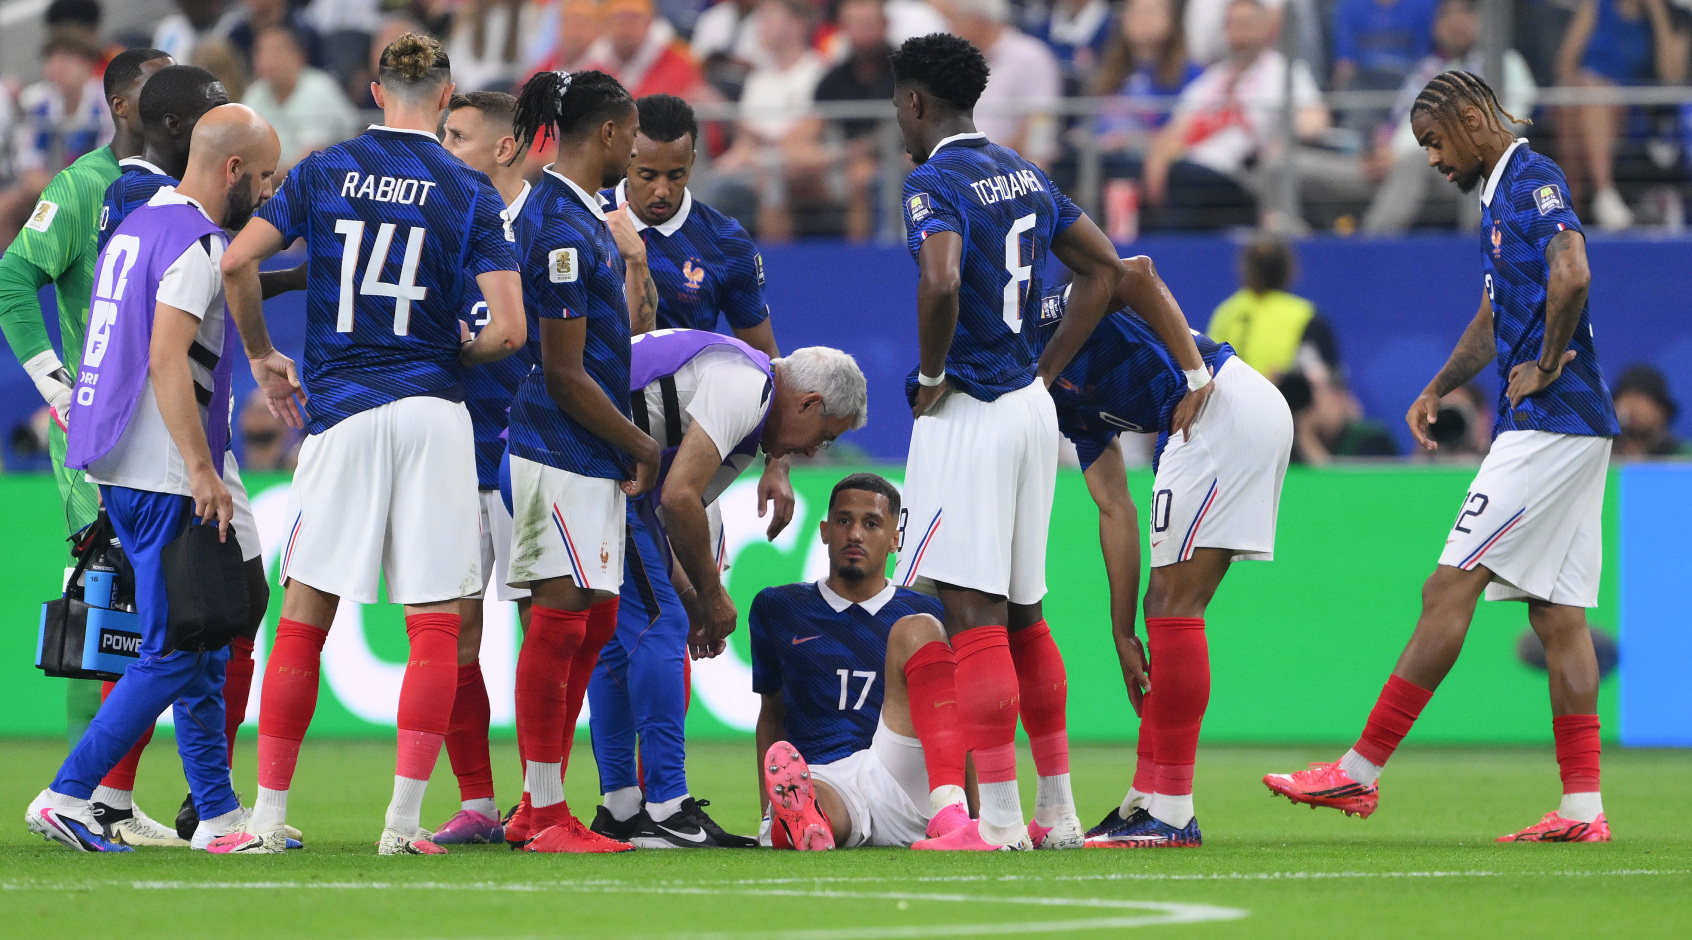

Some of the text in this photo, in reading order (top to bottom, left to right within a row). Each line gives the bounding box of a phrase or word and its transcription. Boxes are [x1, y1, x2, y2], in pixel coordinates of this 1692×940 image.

[341, 171, 436, 206] RABIOT
[334, 218, 428, 337] 14
[278, 666, 313, 678] FFF
[836, 668, 877, 711] 17
